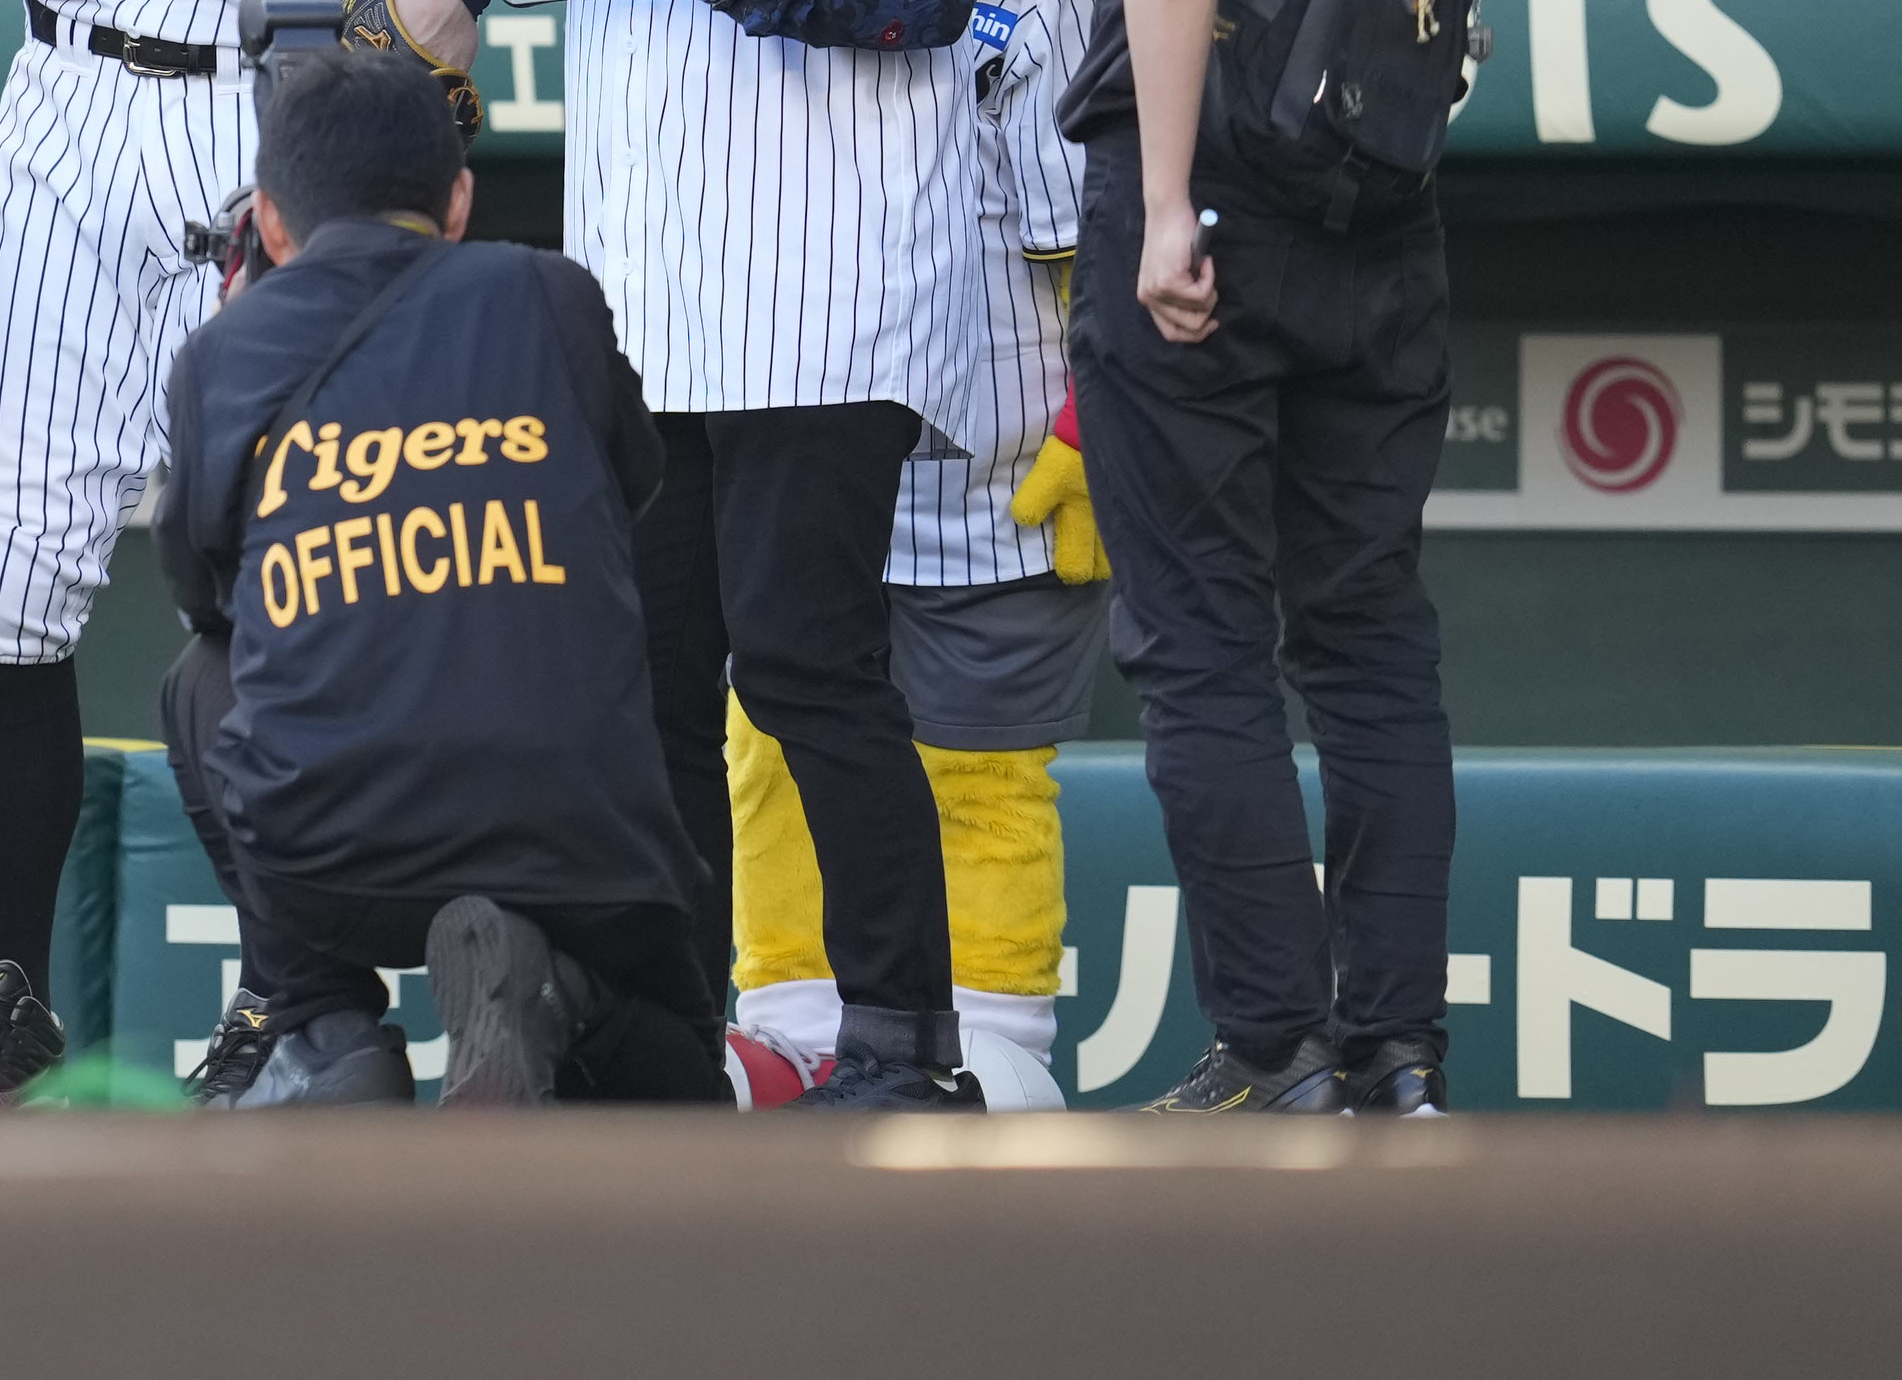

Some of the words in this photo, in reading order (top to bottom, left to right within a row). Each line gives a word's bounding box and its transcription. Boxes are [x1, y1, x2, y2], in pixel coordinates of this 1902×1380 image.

[971, 7, 1011, 42] hin
[255, 415, 549, 519] Tigers
[1742, 382, 1902, 461] シモ
[260, 499, 566, 629] OFFICIAL
